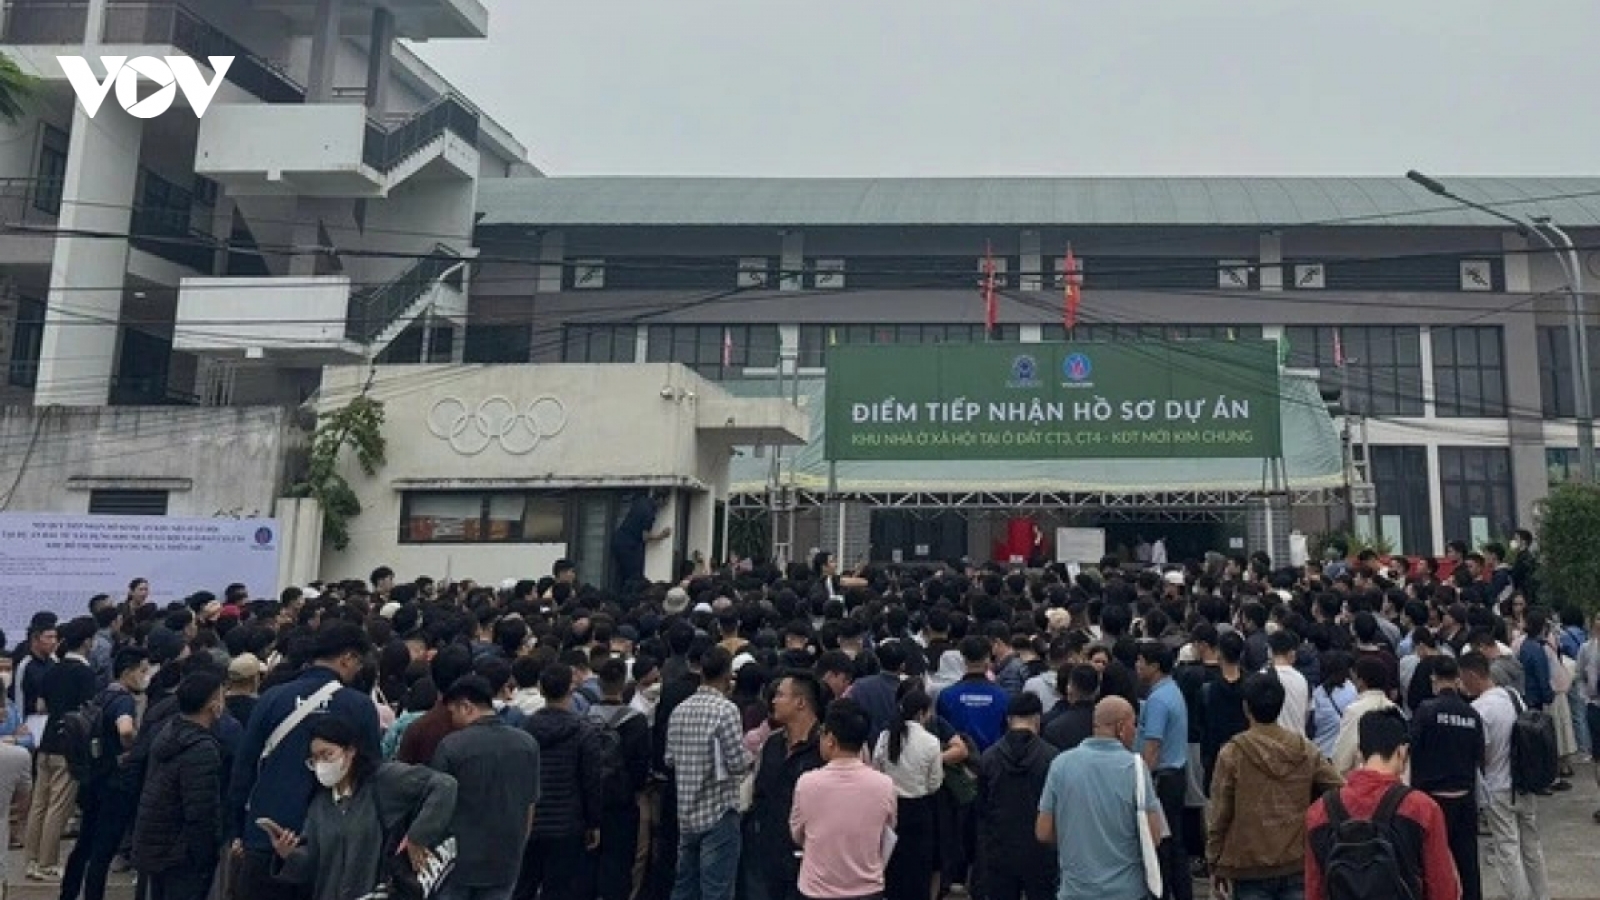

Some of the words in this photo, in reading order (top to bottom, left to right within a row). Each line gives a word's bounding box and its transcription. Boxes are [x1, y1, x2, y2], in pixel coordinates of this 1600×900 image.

[852, 395, 917, 421] ĐIỂM
[925, 395, 980, 421] TIẾP
[989, 397, 1063, 425] NHẬN
[1074, 394, 1112, 421] HỒ
[1120, 399, 1156, 421] SƠ
[1165, 398, 1206, 423] DỰ
[1212, 395, 1249, 419] ÁN
